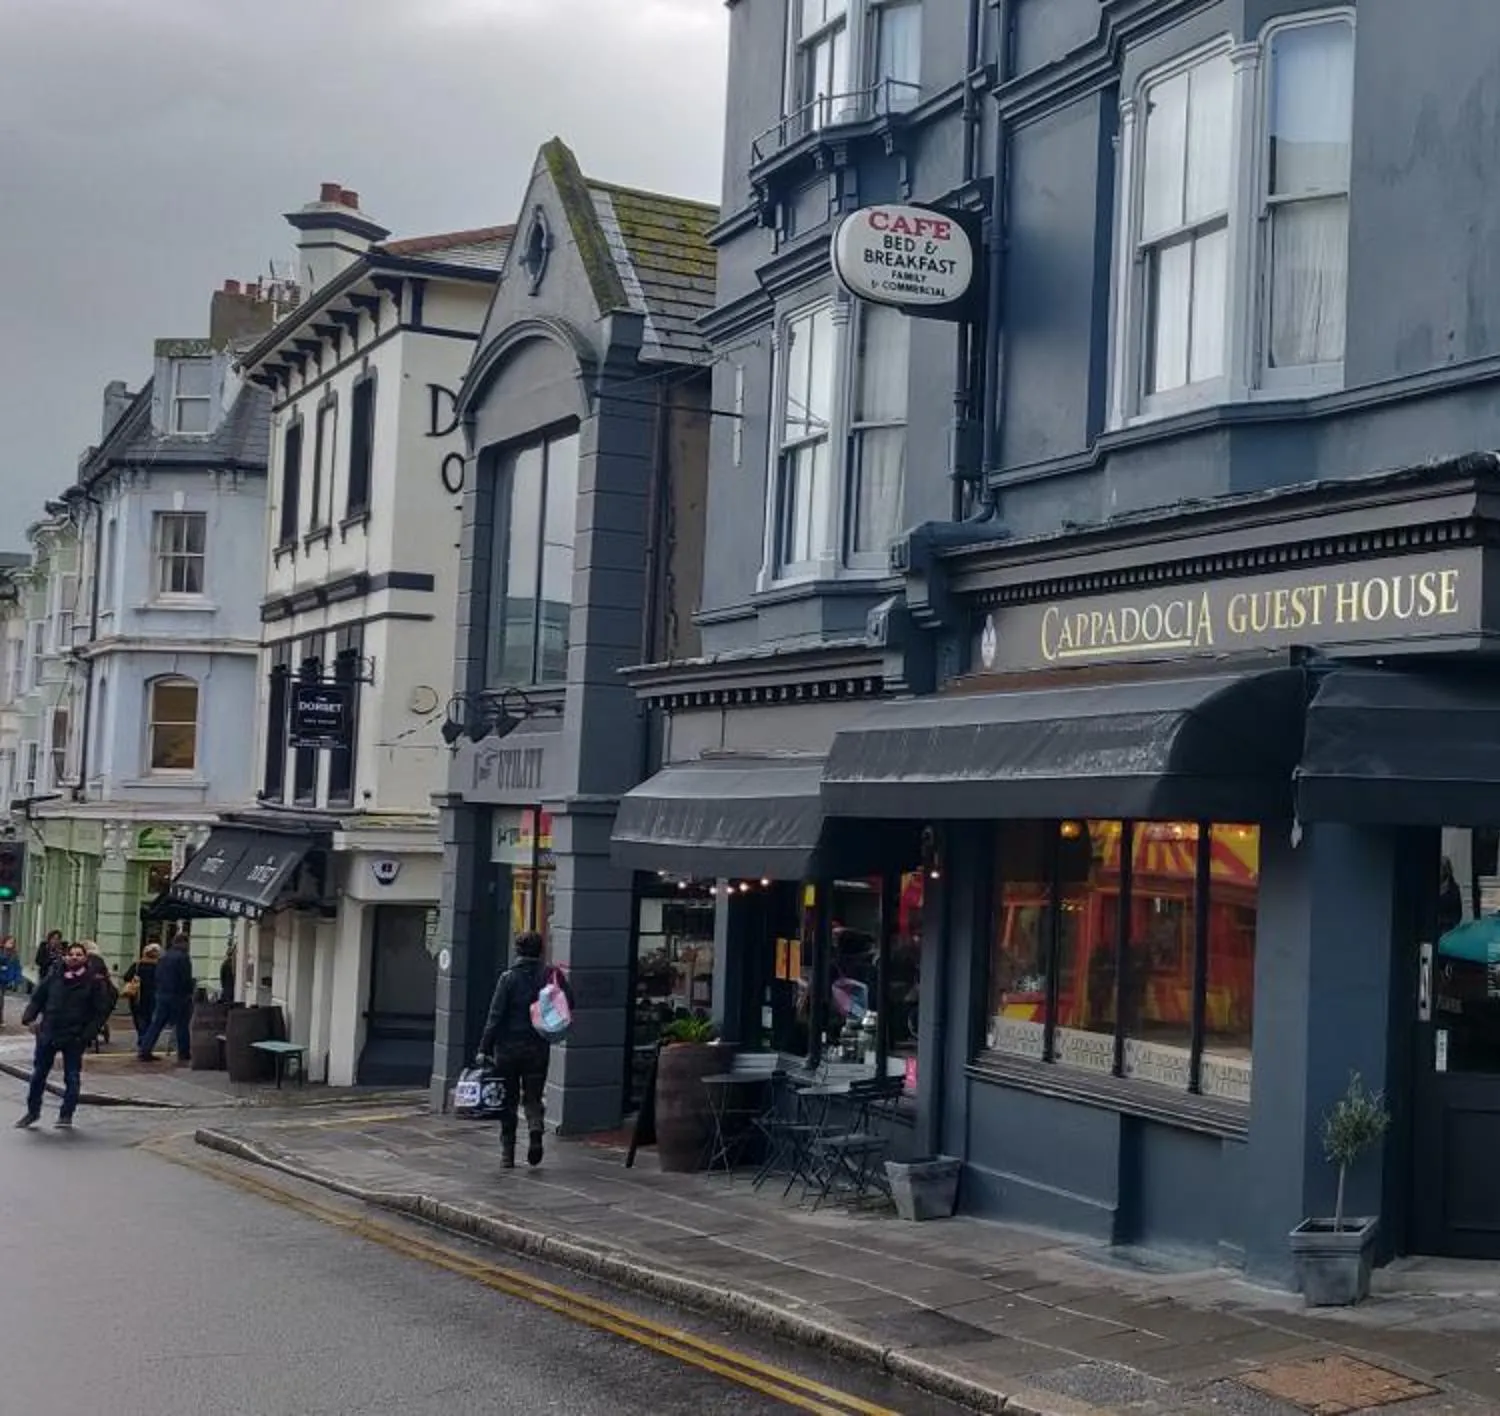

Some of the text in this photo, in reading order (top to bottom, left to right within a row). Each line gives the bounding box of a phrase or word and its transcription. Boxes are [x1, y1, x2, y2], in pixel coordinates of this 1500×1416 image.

[868, 211, 951, 240] CAFE
[883, 235, 938, 255] BED &
[863, 249, 957, 275] BREAKFAST
[891, 270, 927, 283] FAMILY
[882, 281, 946, 297] COMMERCIAL
[1039, 568, 1461, 661] CAPPADOCIA GUEST HOUSE
